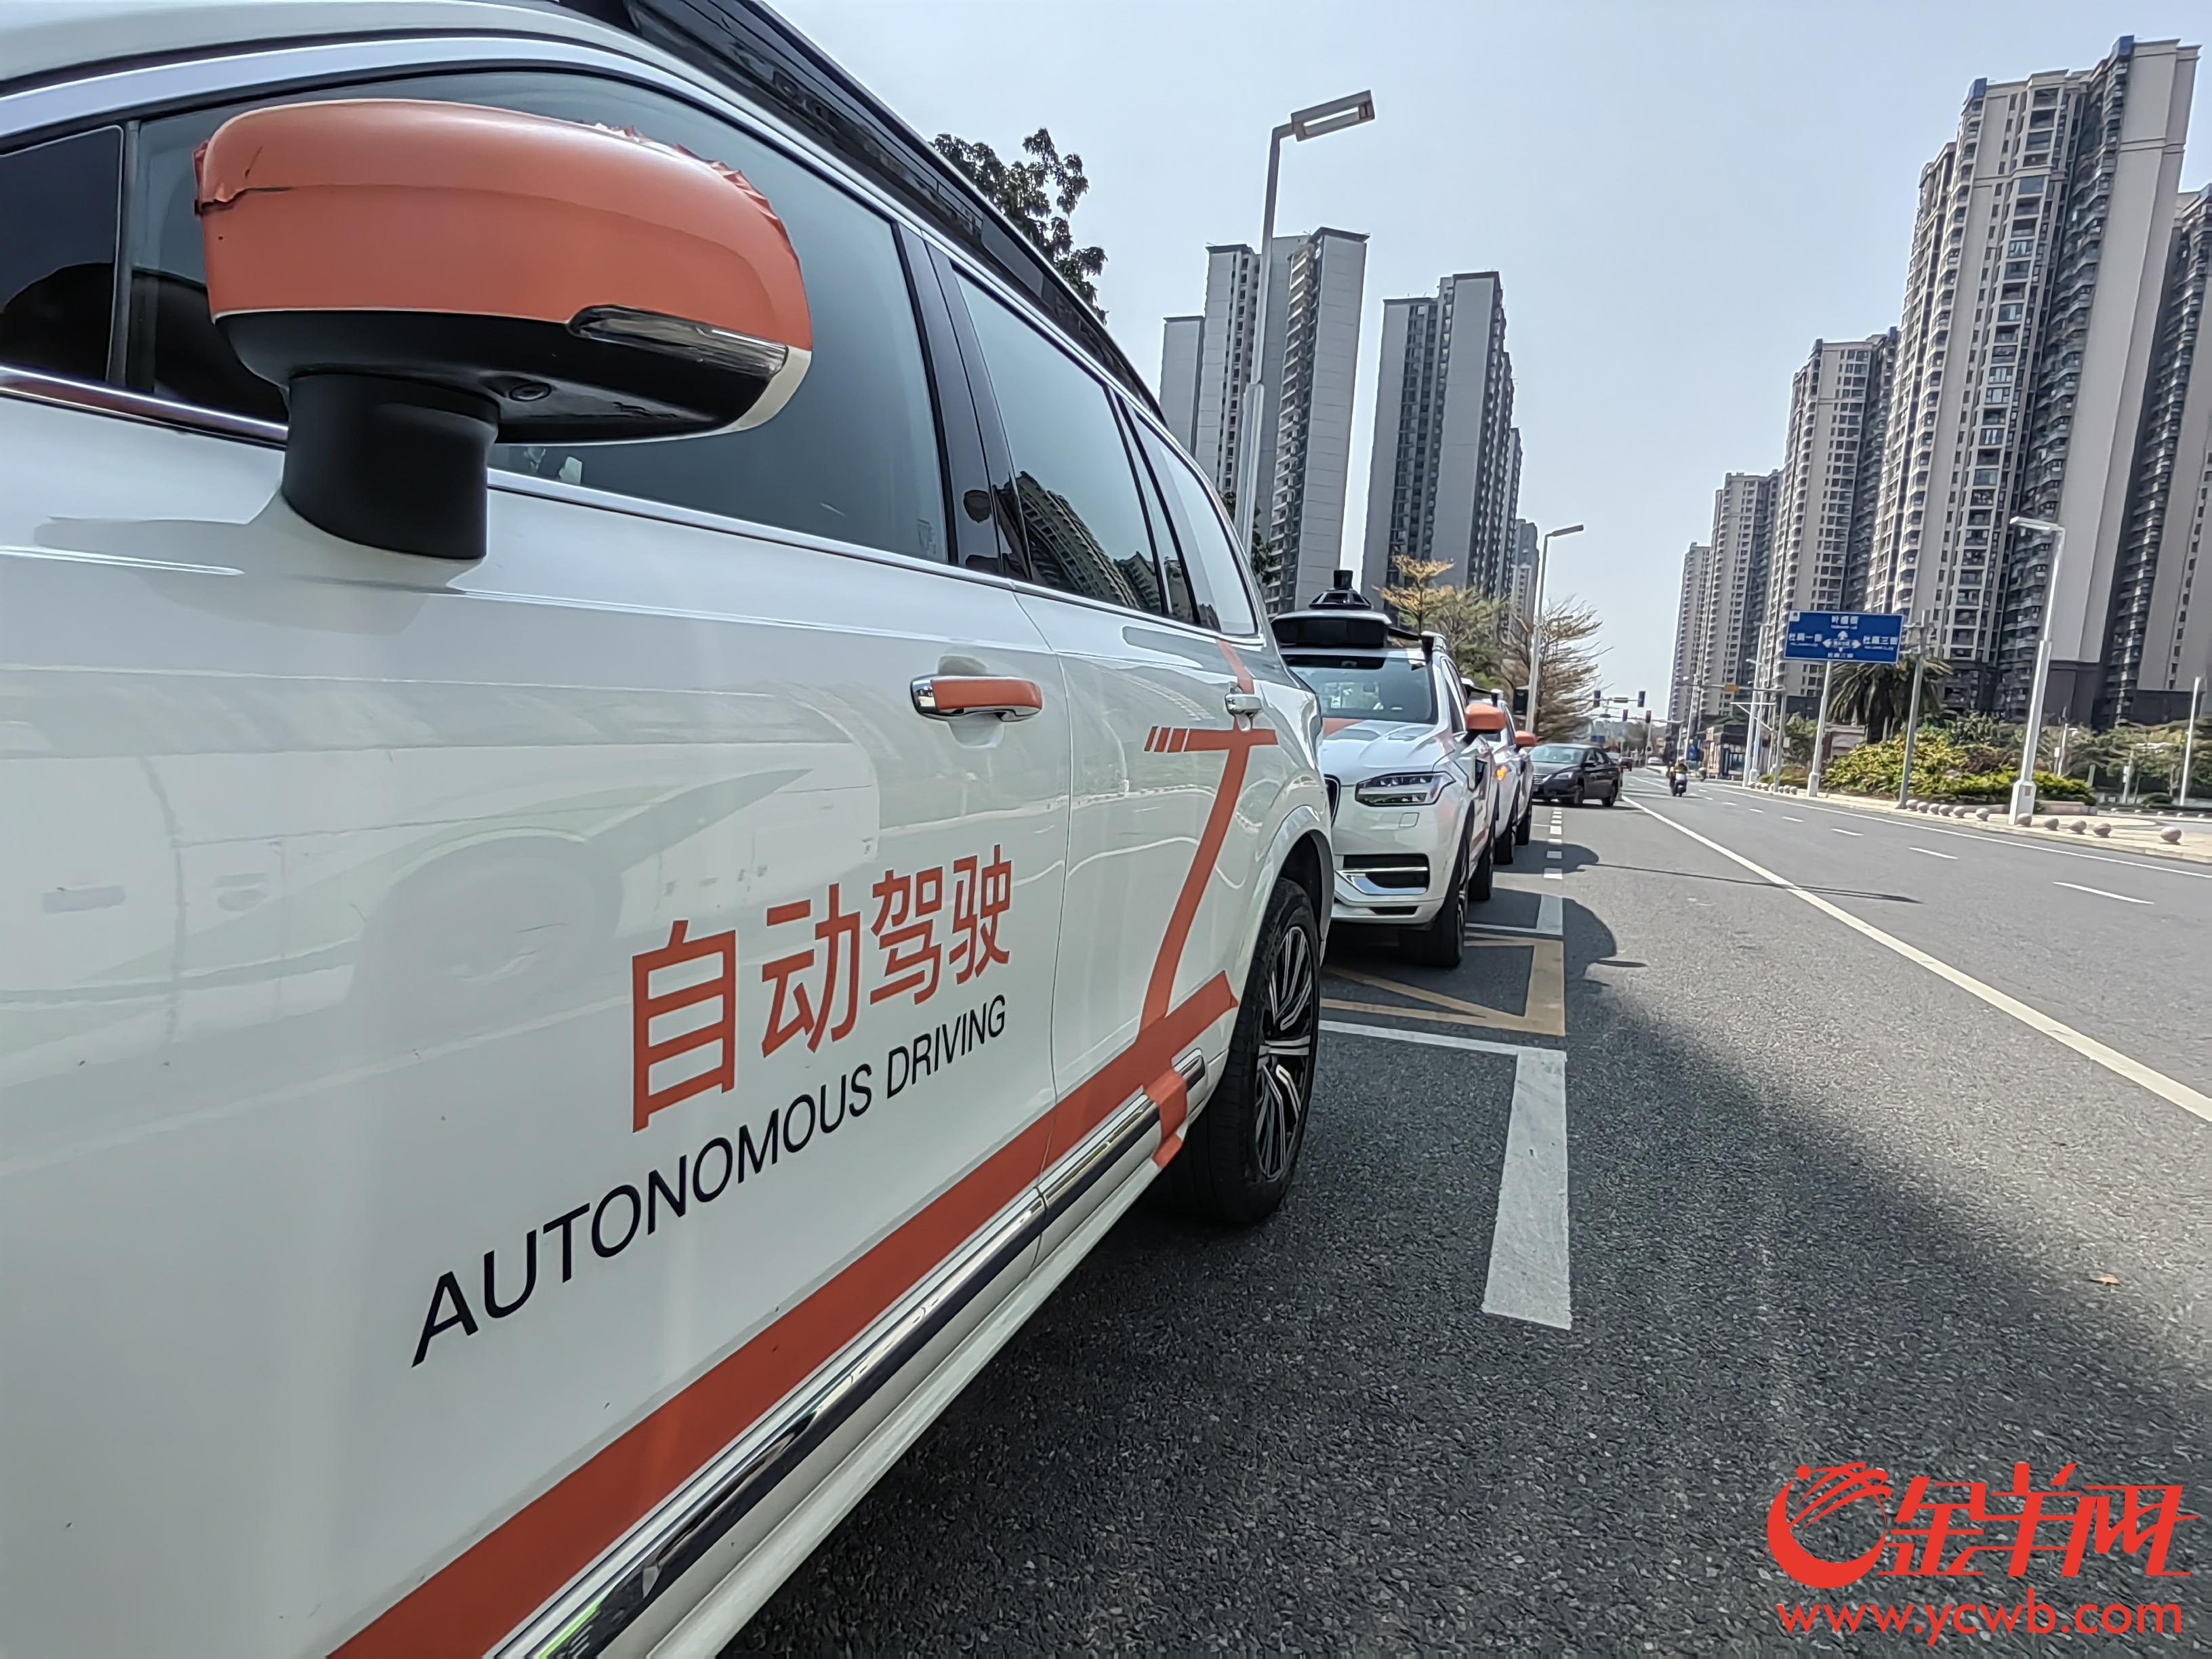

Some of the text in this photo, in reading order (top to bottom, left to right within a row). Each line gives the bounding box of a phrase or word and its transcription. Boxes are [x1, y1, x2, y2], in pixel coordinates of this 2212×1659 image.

[633, 844, 1012, 1132] 自动驾驶
[412, 994, 1006, 1368] AUTONOMOUS DRIVING
